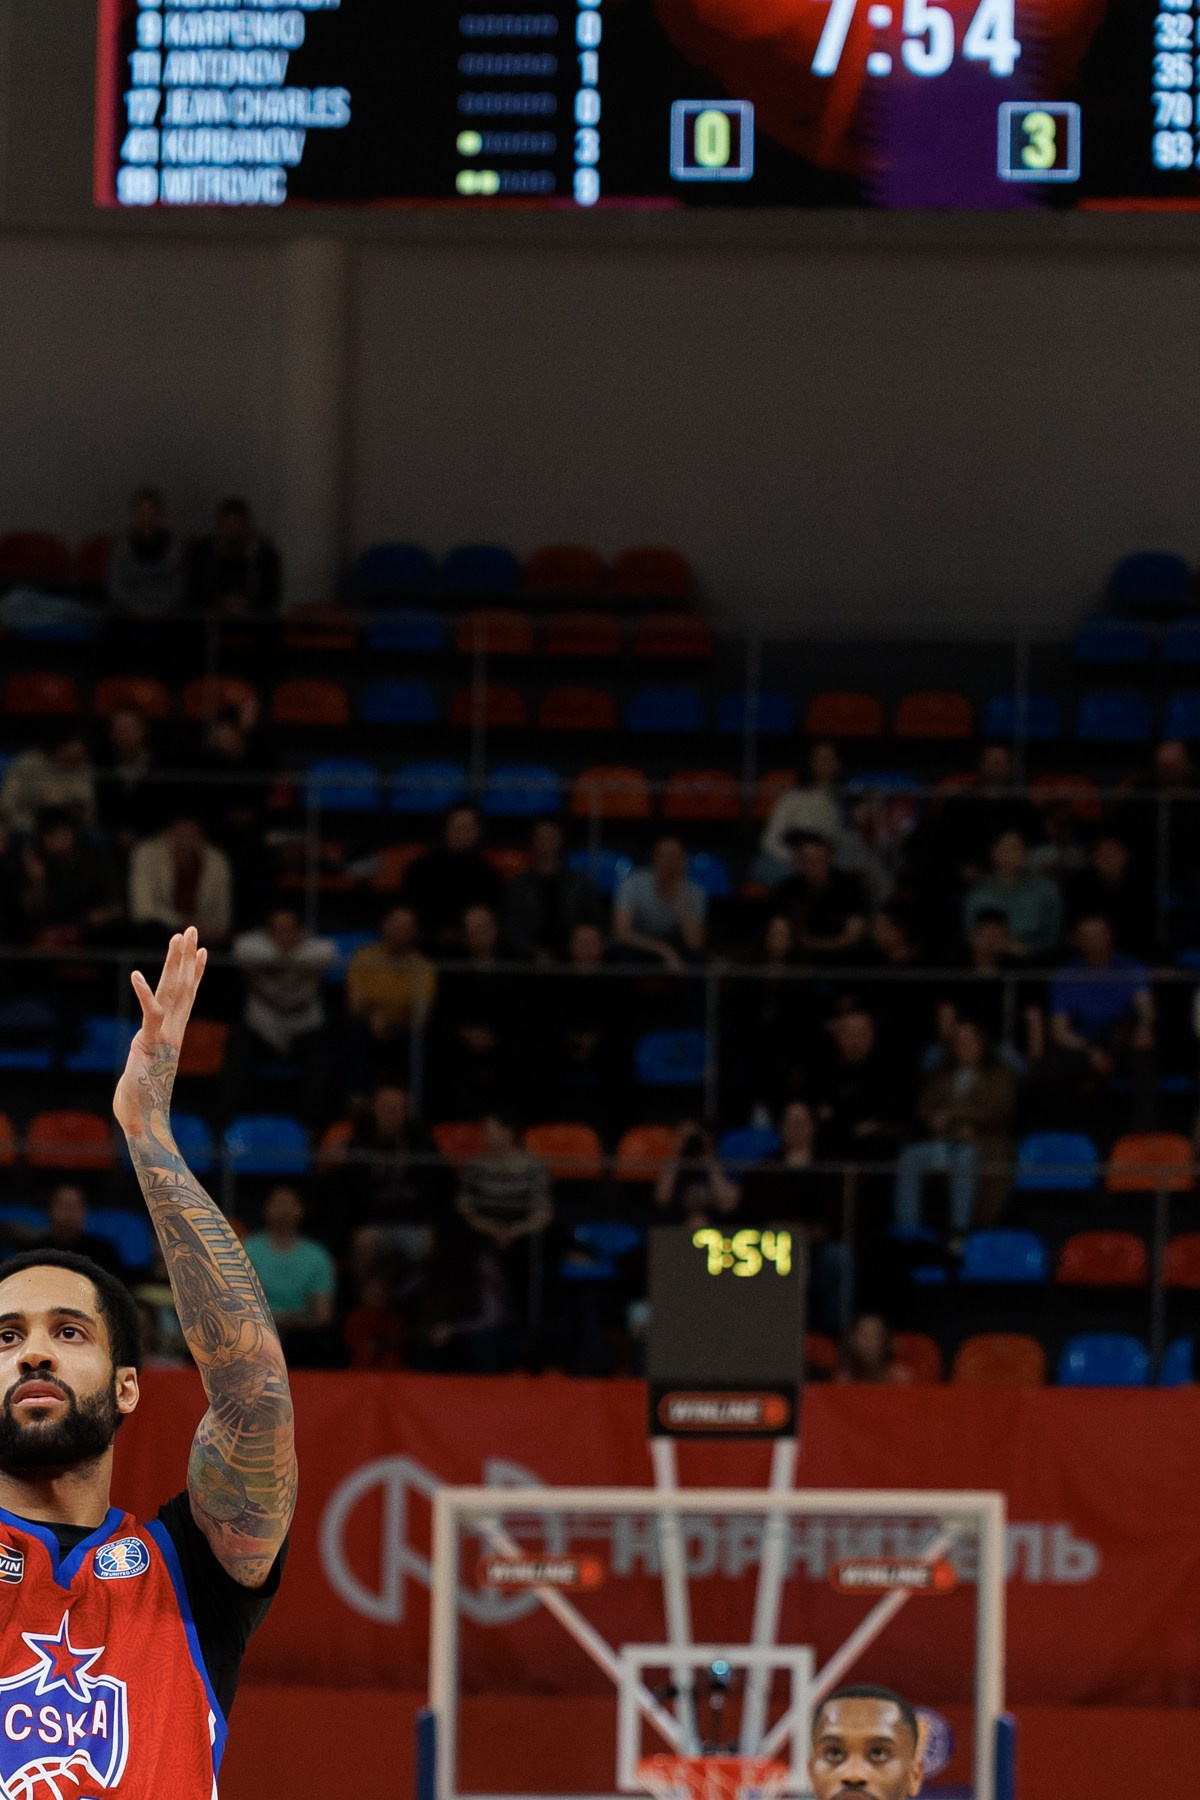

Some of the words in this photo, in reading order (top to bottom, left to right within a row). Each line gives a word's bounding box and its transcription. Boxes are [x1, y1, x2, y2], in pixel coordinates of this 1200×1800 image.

[1153, 12, 1194, 50] 32
[577, 50, 599, 87] 1
[1152, 51, 1193, 90] 35
[574, 127, 600, 165] 3
[693, 109, 731, 168] 0
[1021, 110, 1057, 170] 3
[693, 1228, 791, 1277] 7:54
[3, 1699, 109, 1747] CSKA
